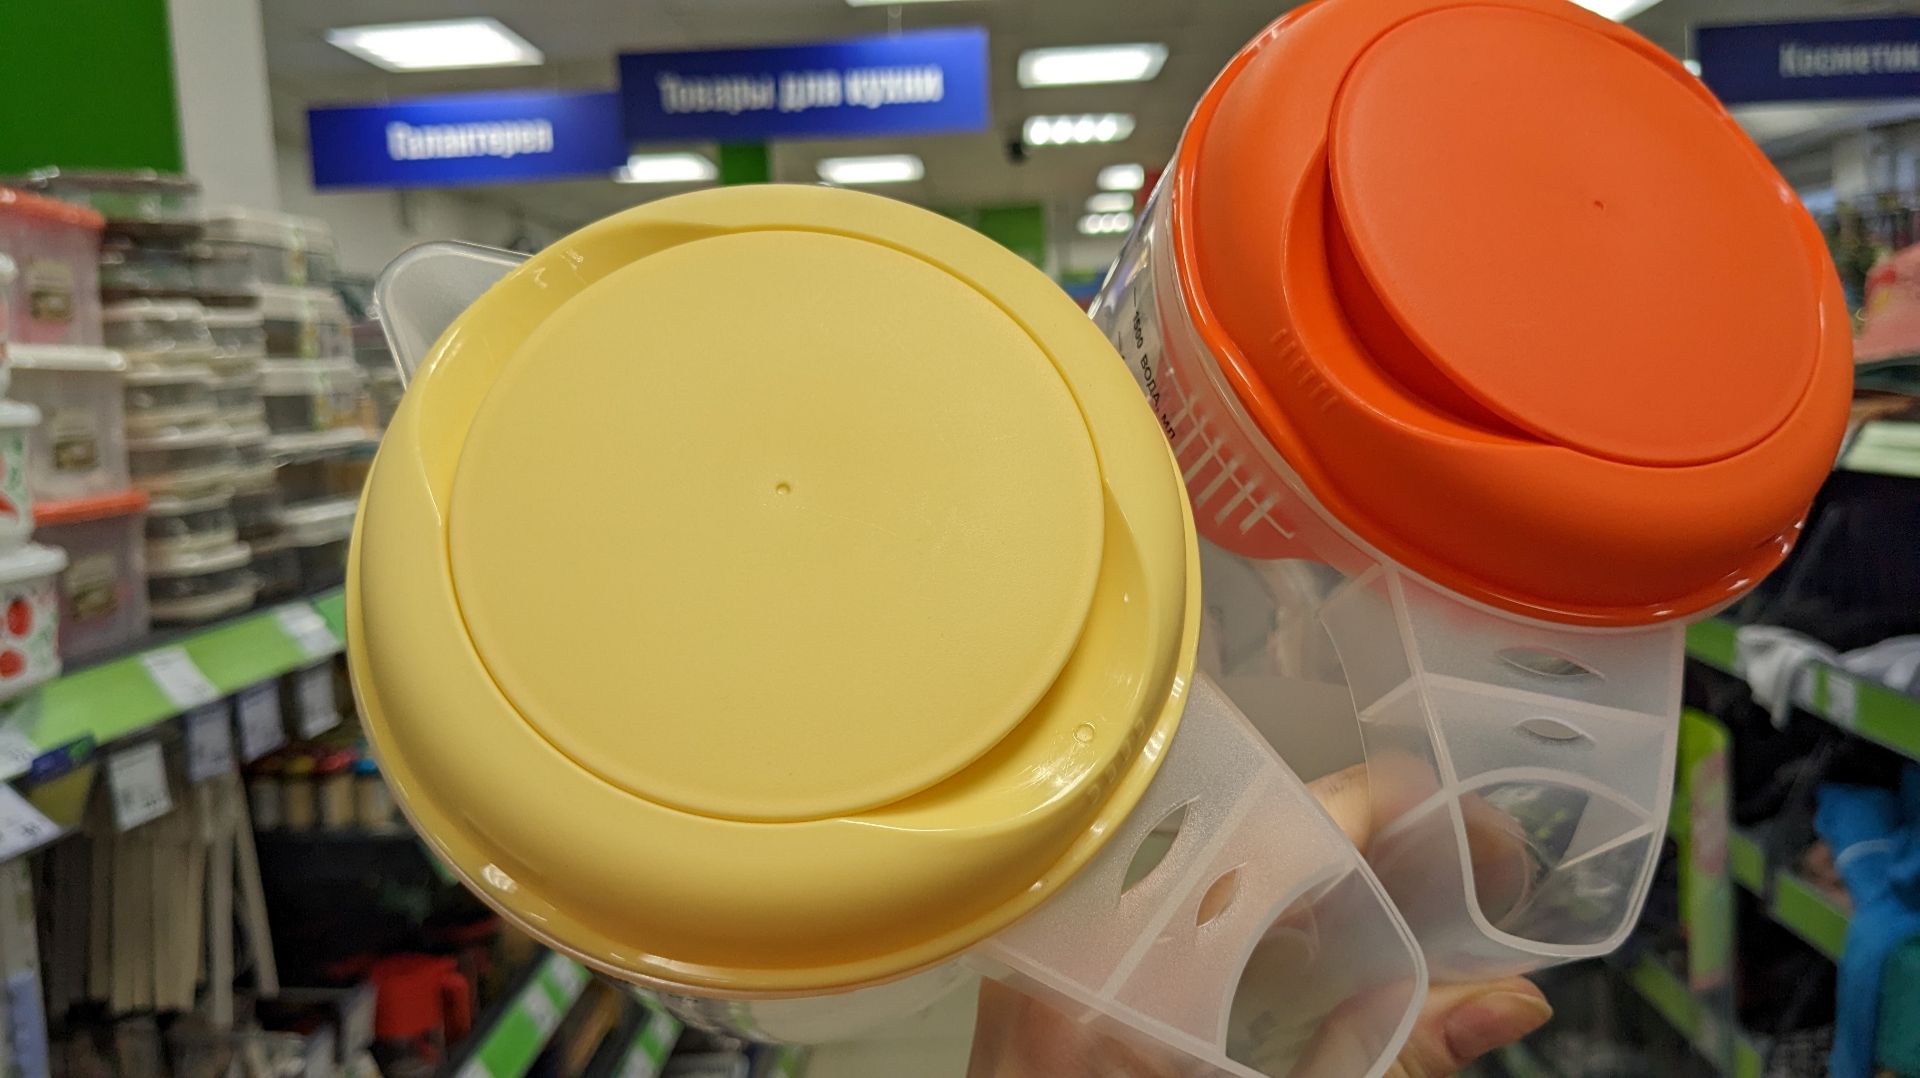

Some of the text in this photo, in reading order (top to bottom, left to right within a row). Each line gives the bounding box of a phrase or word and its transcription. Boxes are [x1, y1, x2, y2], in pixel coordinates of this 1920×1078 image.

[778, 71, 842, 112] для
[844, 65, 944, 109] кухни
[1132, 311, 1144, 349] 1500
[1140, 353, 1161, 412] ВОДА,
